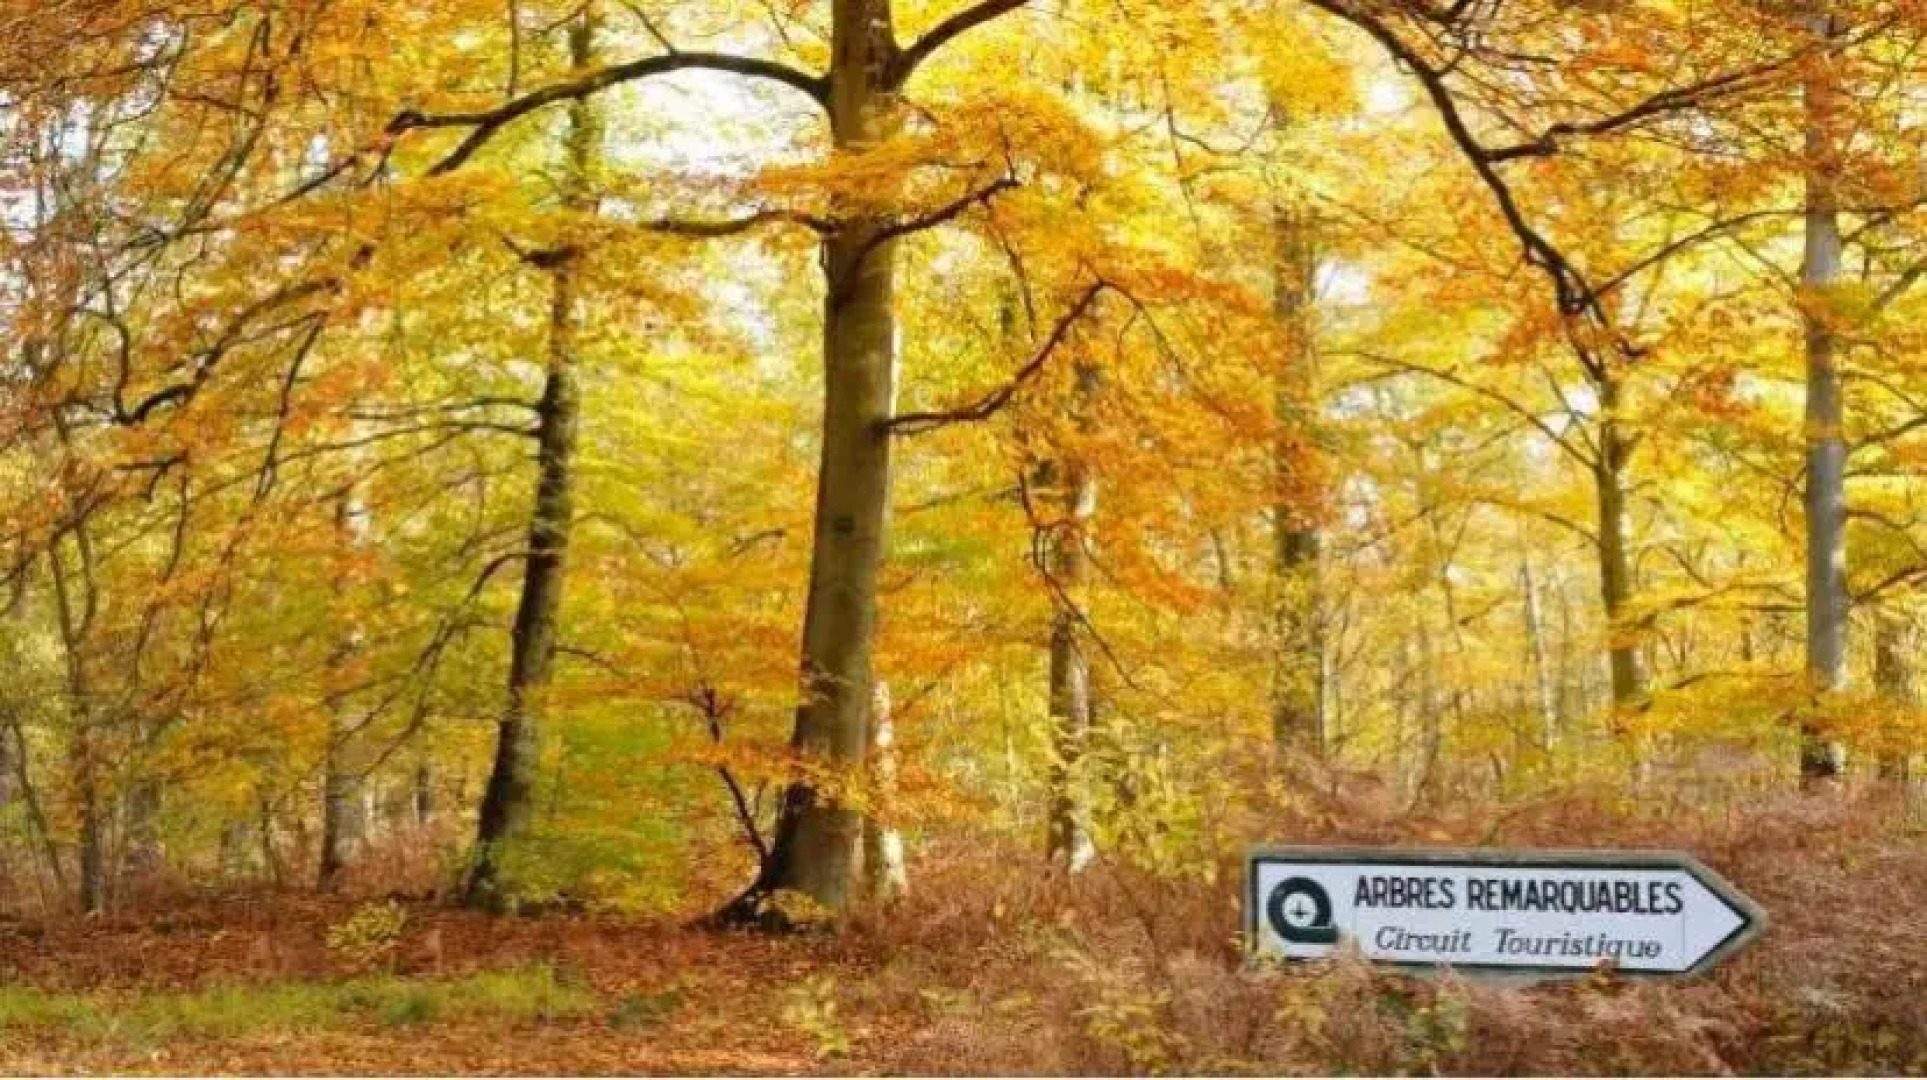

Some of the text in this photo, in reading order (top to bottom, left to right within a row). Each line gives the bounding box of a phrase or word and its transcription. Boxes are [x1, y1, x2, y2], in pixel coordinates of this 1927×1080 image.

[1353, 875, 1684, 915] ARBRES REMARQUABLES
[1375, 926, 1662, 961] Circuit Touristique
